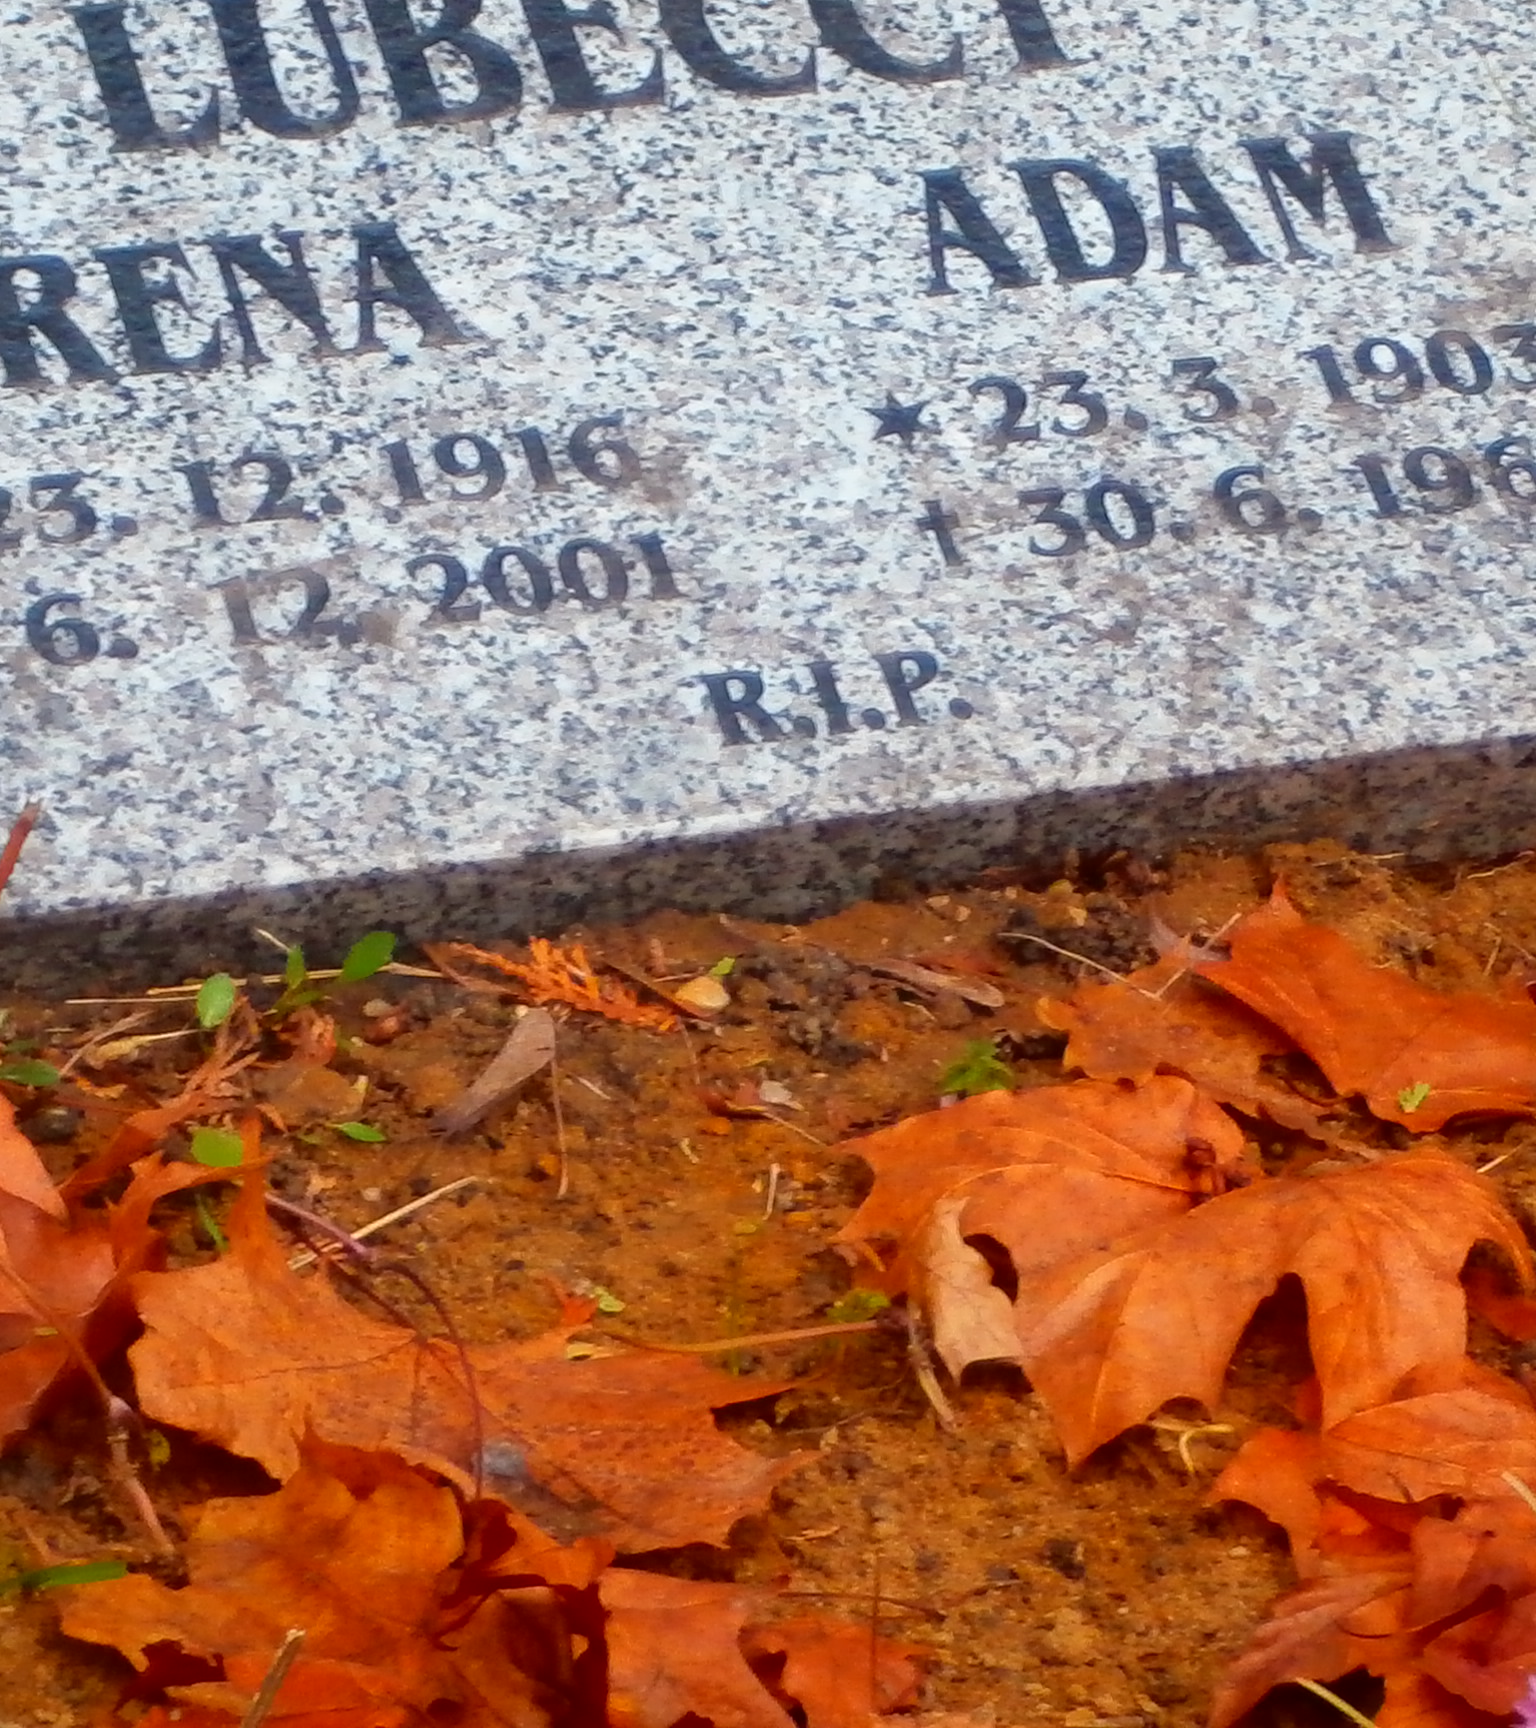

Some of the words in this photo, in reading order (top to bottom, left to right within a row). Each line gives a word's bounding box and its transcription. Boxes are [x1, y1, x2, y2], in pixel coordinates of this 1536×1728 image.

[917, 130, 1400, 296] ADAM
[380, 416, 641, 507] 1916
[406, 532, 690, 624] 2001
[696, 650, 975, 746] R.I.P.
